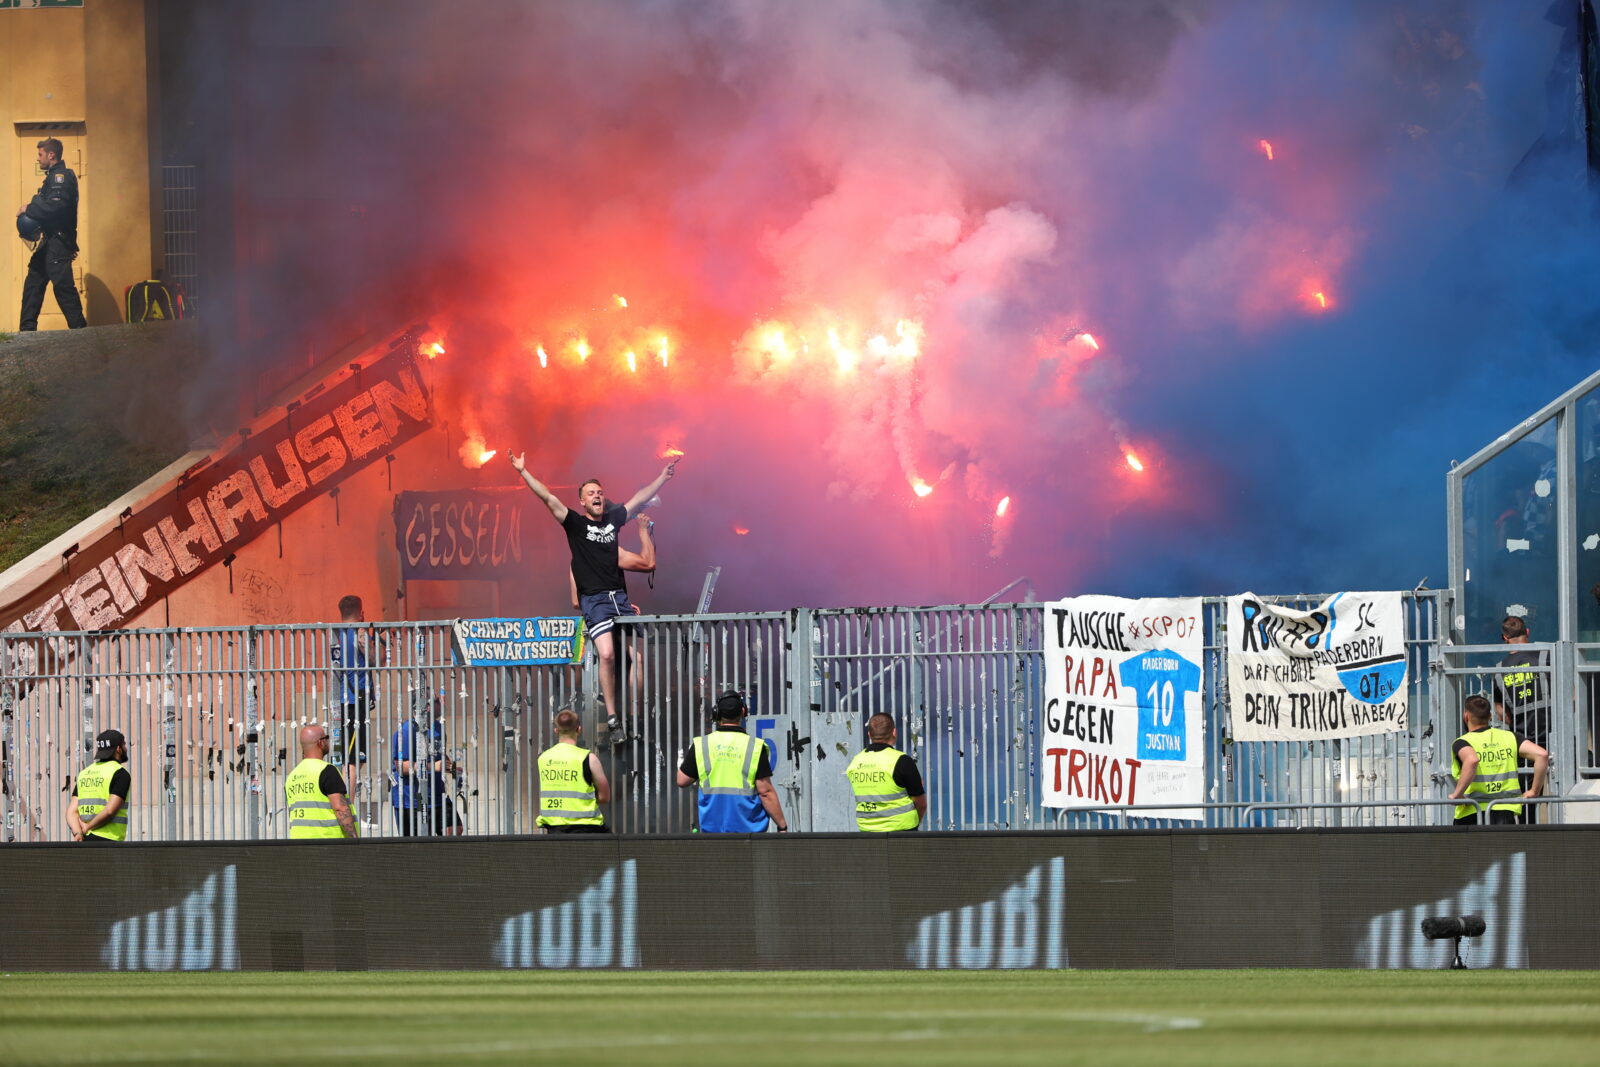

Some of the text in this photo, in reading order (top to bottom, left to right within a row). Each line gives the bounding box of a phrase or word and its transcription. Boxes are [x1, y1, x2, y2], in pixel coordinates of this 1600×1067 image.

[405, 501, 522, 567] GESSELN
[461, 619, 575, 638] SCHNAPS & WEED
[1052, 608, 1130, 651] TAUSCHE
[1355, 602, 1376, 632] SC
[467, 640, 574, 660] AUSWÄRTSSIEG!
[1141, 657, 1179, 671] PADERBORN
[1313, 635, 1383, 666] PADERBORN
[1065, 655, 1118, 699] PAPA
[1244, 664, 1269, 681] DARF
[1360, 672, 1379, 699] 07
[1147, 680, 1175, 726] 10
[1245, 693, 1281, 729] DEIN
[1289, 688, 1348, 731] TRIKOT
[1047, 698, 1114, 744] GEGEN
[756, 719, 777, 773] 5
[80, 778, 104, 788] RDNER
[1046, 748, 1141, 805] TRIKOT
[1486, 782, 1502, 792] 129
[81, 805, 95, 814] 148
